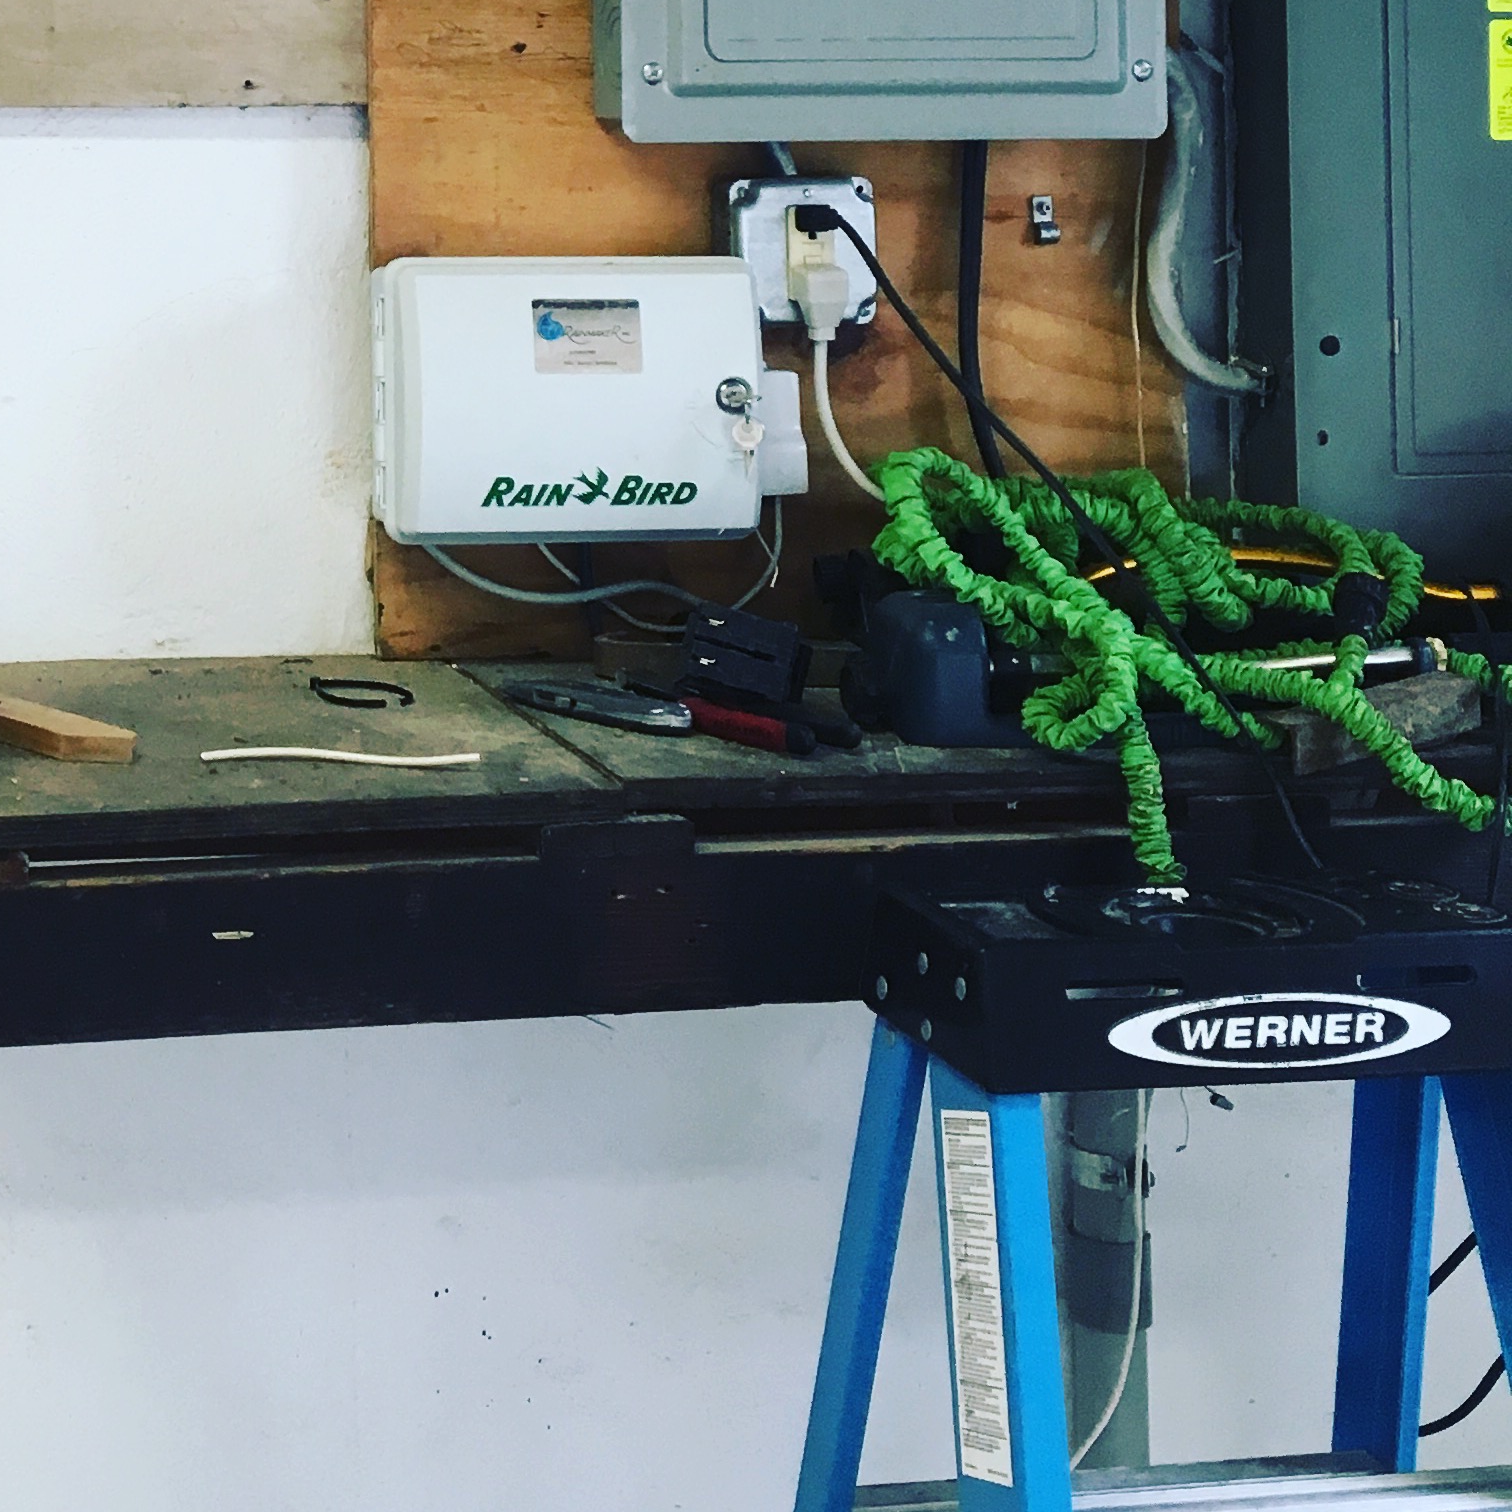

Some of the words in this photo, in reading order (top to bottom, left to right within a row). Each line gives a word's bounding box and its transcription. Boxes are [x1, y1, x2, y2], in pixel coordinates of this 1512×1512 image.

[481, 476, 575, 507] RAIN
[610, 475, 698, 506] BIRD
[1181, 1012, 1385, 1051] WERNER
